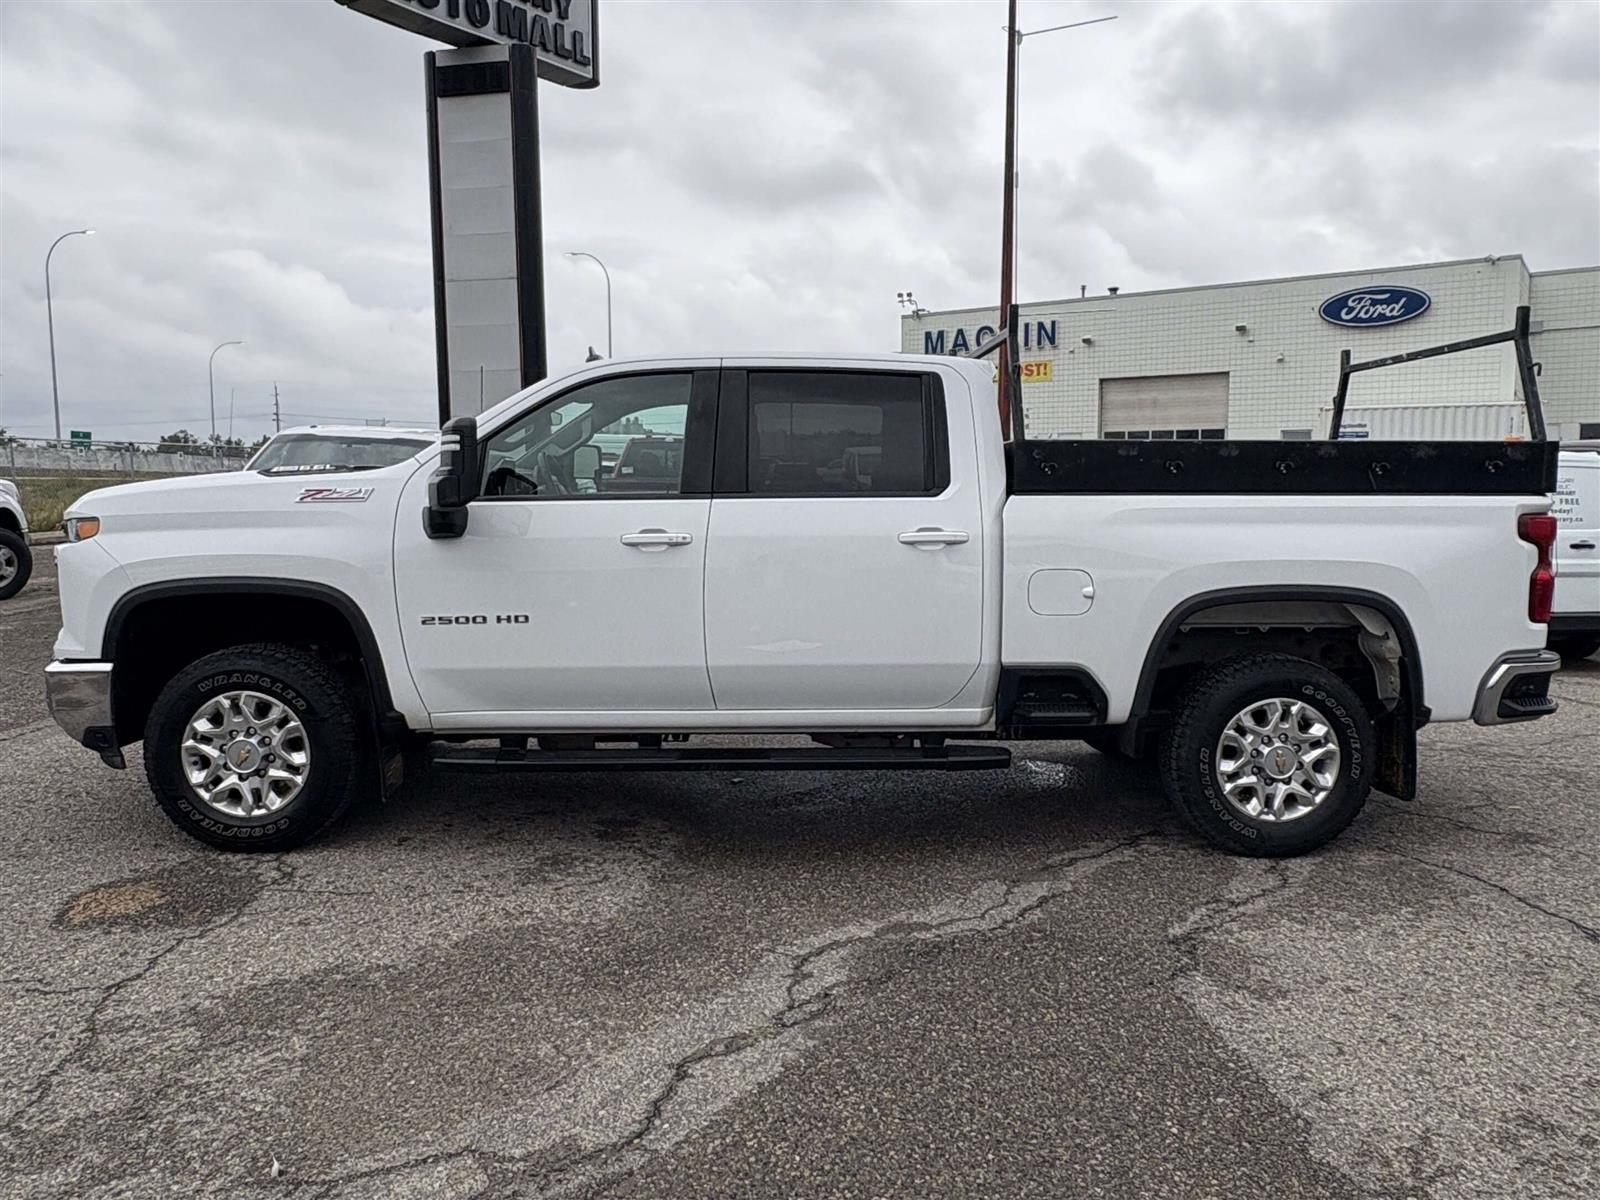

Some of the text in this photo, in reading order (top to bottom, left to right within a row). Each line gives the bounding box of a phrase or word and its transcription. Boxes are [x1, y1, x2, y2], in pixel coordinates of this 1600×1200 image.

[497, 0, 591, 66] MALL
[1340, 292, 1407, 320] Ford
[924, 320, 1057, 354] MACIN
[296, 487, 374, 503] Z71
[420, 614, 529, 626] 2500 HD
[198, 673, 307, 710] WRANGLER
[1302, 685, 1362, 779] GOODYEAR
[1201, 747, 1257, 838] WRANGLER
[178, 799, 290, 837] GOODYEAR
